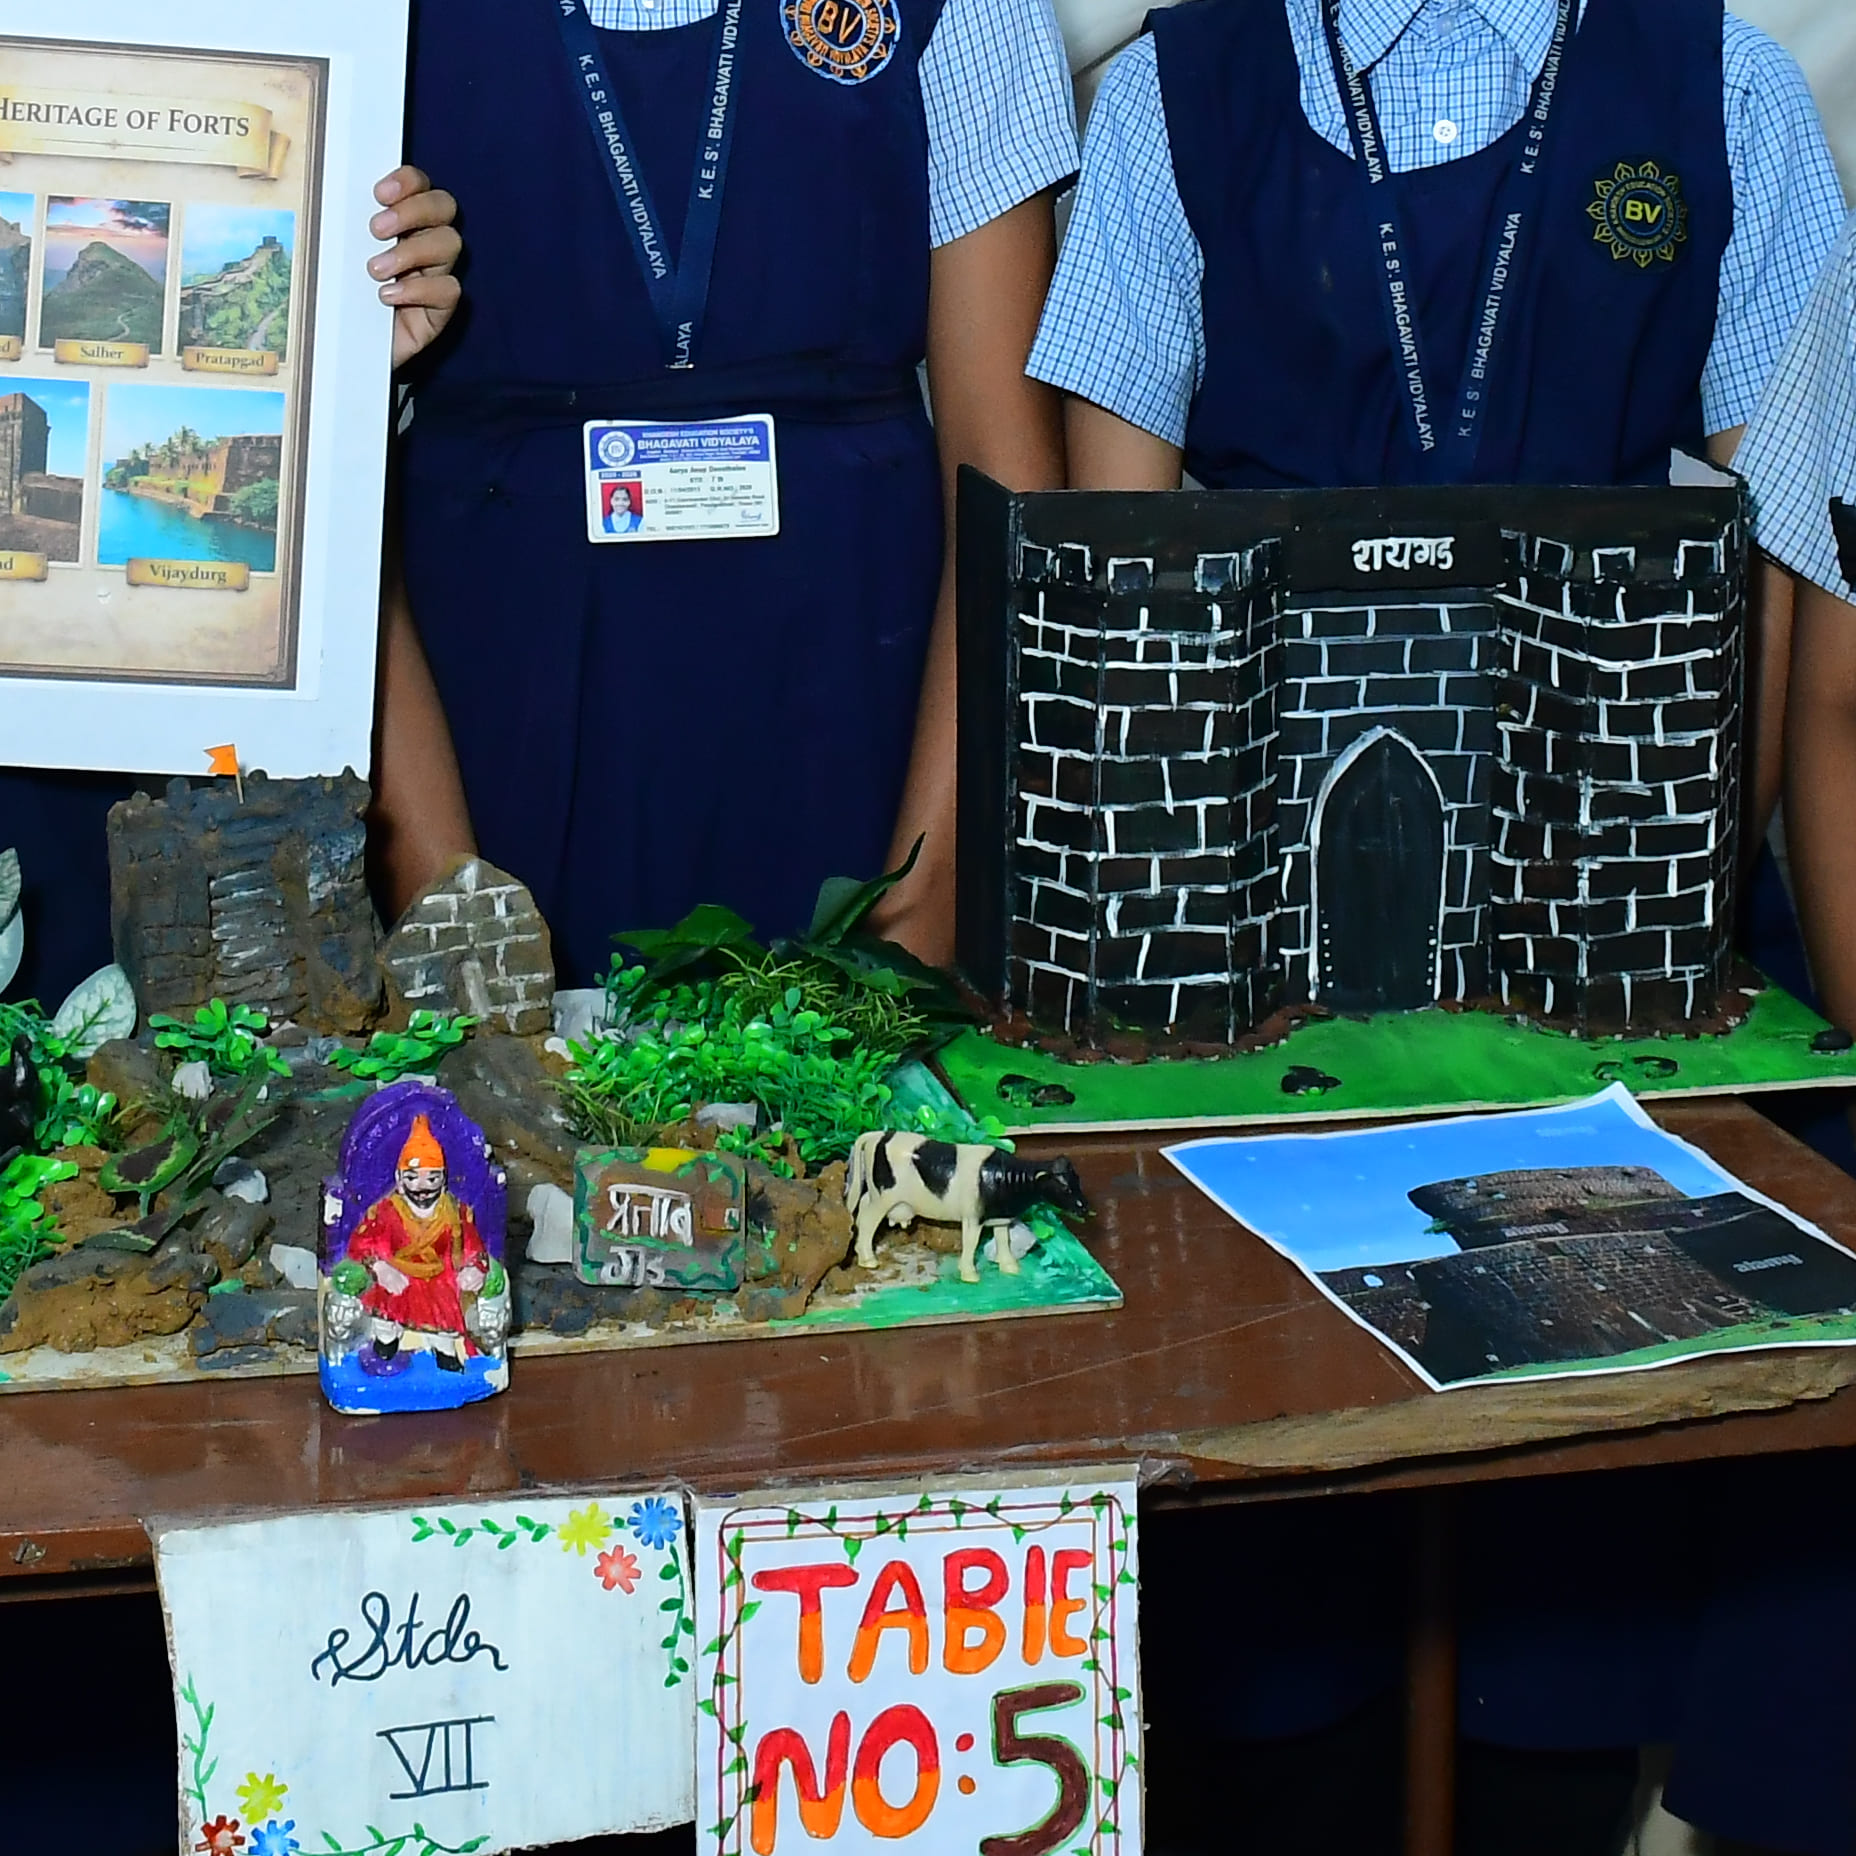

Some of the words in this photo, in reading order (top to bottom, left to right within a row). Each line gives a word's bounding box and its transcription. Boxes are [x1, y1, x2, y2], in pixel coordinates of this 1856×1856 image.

[818, 0, 861, 43] BV
[169, 109, 249, 136] FORTS
[598, 111, 639, 196] BHAGAVATI
[630, 197, 667, 279] VIDYALAYA
[1625, 200, 1661, 223] BV
[80, 344, 125, 363] Salher
[194, 351, 266, 372] Pratapgad
[1390, 281, 1418, 367] BHAGAVATI
[1407, 369, 1435, 451] VIDYALAYA
[638, 438, 699, 450] BHAGAVATI
[701, 436, 760, 447] VIDYALAYA
[149, 562, 228, 586] Vijaydurg
[376, 1715, 495, 1799] VII
[979, 1680, 1091, 1856] 5
